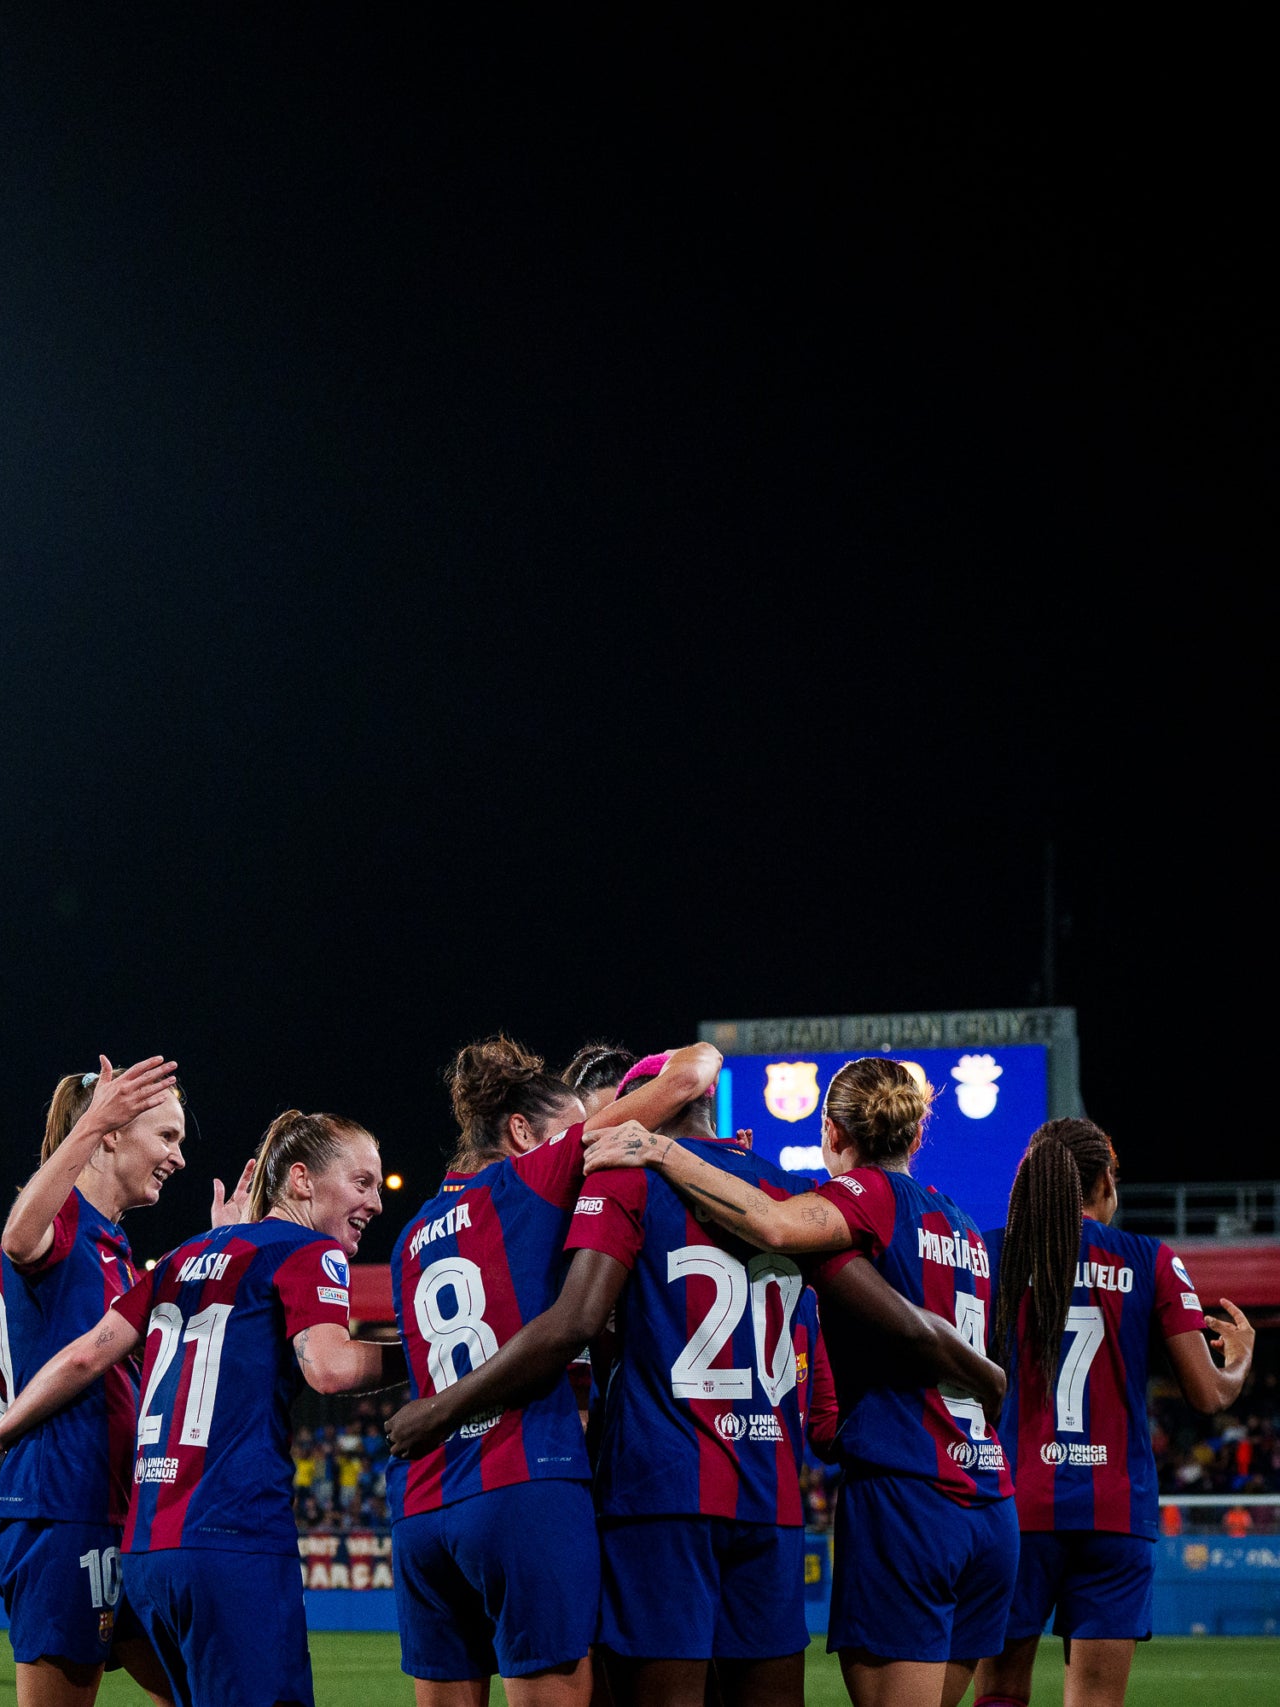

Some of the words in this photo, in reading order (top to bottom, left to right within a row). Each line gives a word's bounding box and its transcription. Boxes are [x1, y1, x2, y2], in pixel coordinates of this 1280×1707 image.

[409, 1203, 472, 1261] MARTA
[414, 1257, 499, 1394] 8
[667, 1245, 803, 1407] 20
[137, 1302, 235, 1450] 21
[1057, 1306, 1105, 1433] 7
[147, 1457, 180, 1469] UNHCR
[978, 1455, 1005, 1467] ACNUR
[979, 1444, 1002, 1456] UNHCR
[1068, 1452, 1108, 1463] ACNUR
[1069, 1443, 1108, 1454] UNHCR
[145, 1467, 178, 1479] ACNUR
[79, 1546, 123, 1609] 10
